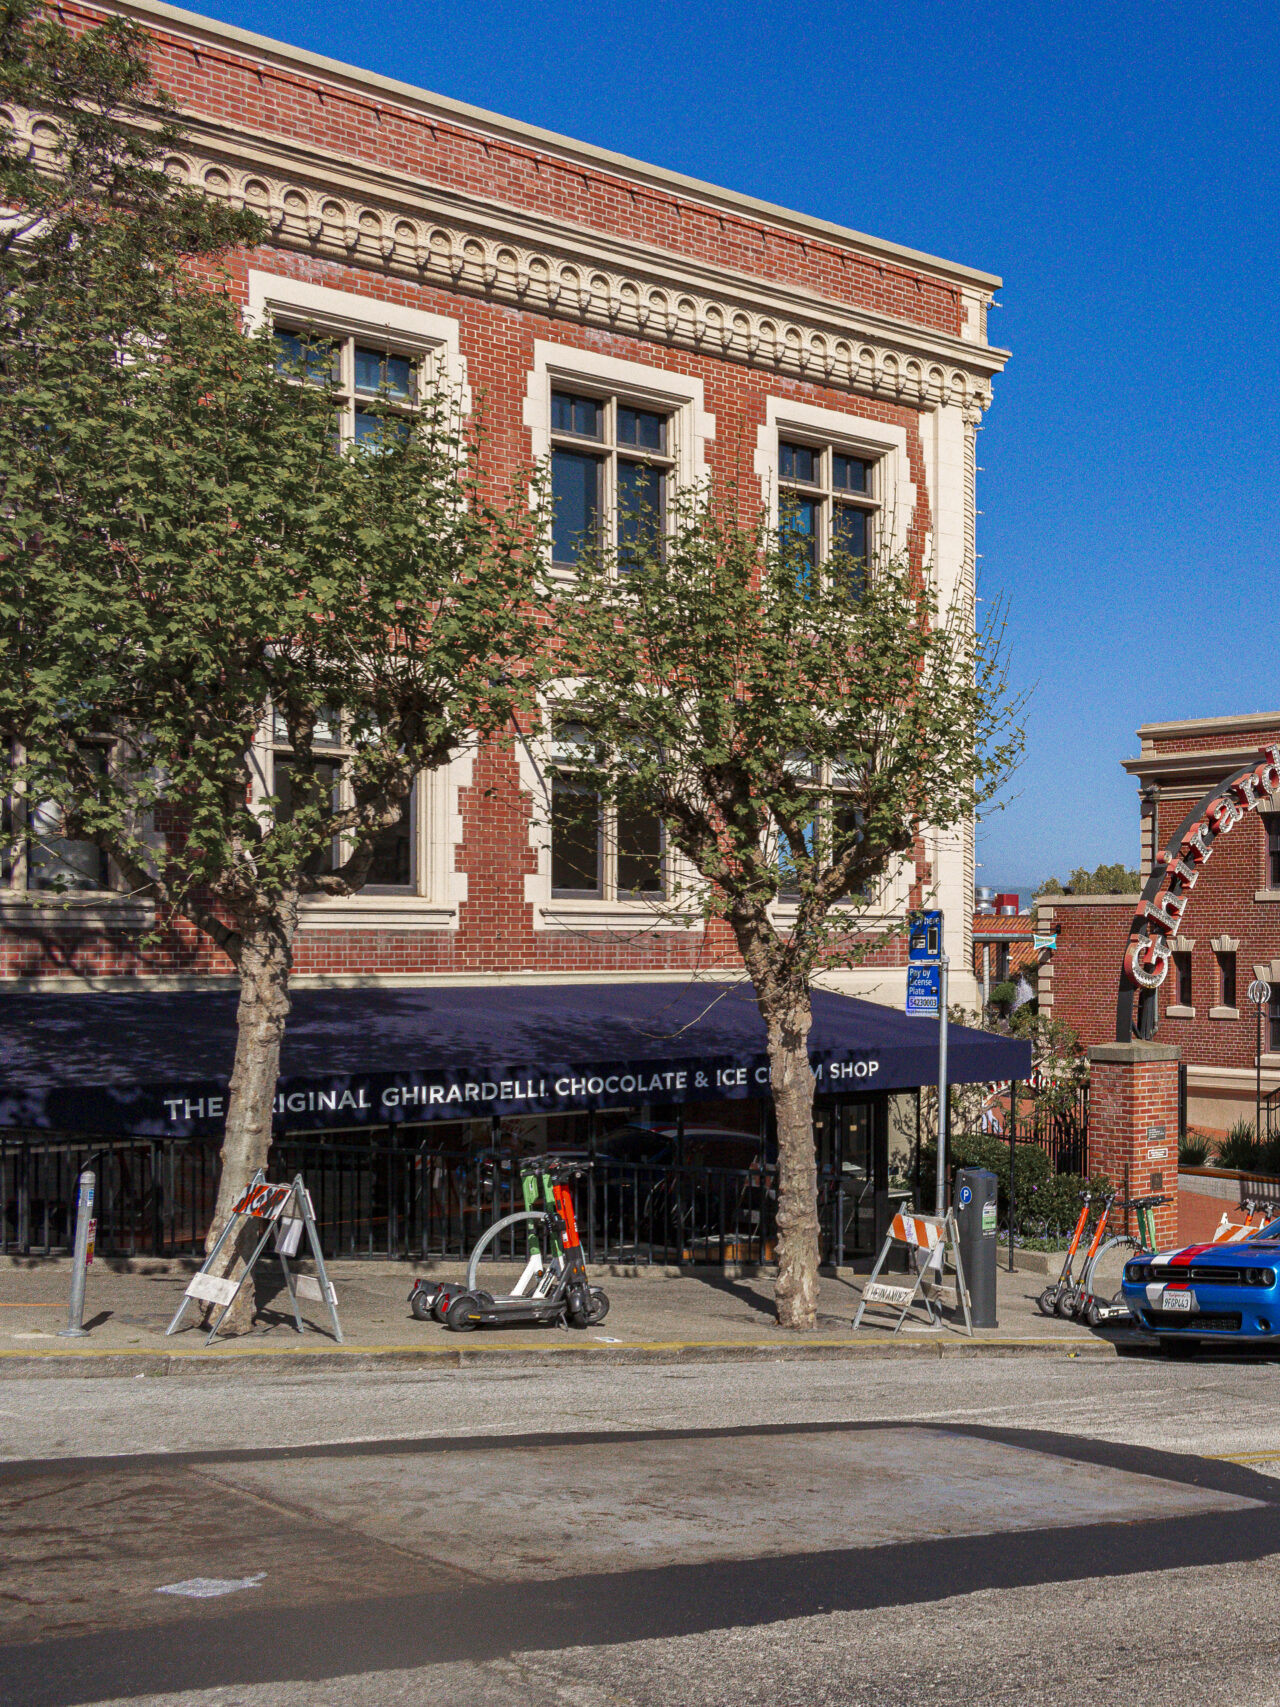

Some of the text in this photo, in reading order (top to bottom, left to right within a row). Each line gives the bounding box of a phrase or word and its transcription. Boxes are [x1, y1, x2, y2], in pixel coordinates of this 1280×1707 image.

[909, 968, 931, 978] Pay by
[909, 978, 933, 986] License
[909, 986, 925, 995] Plate
[163, 1097, 224, 1120] THE
[271, 1089, 372, 1113] IGINAL
[555, 1072, 687, 1096] CHOCOLATE
[694, 1071, 709, 1087] &
[716, 1068, 747, 1086] ICE
[829, 1061, 880, 1079] SHOP
[963, 1189, 970, 1201] P
